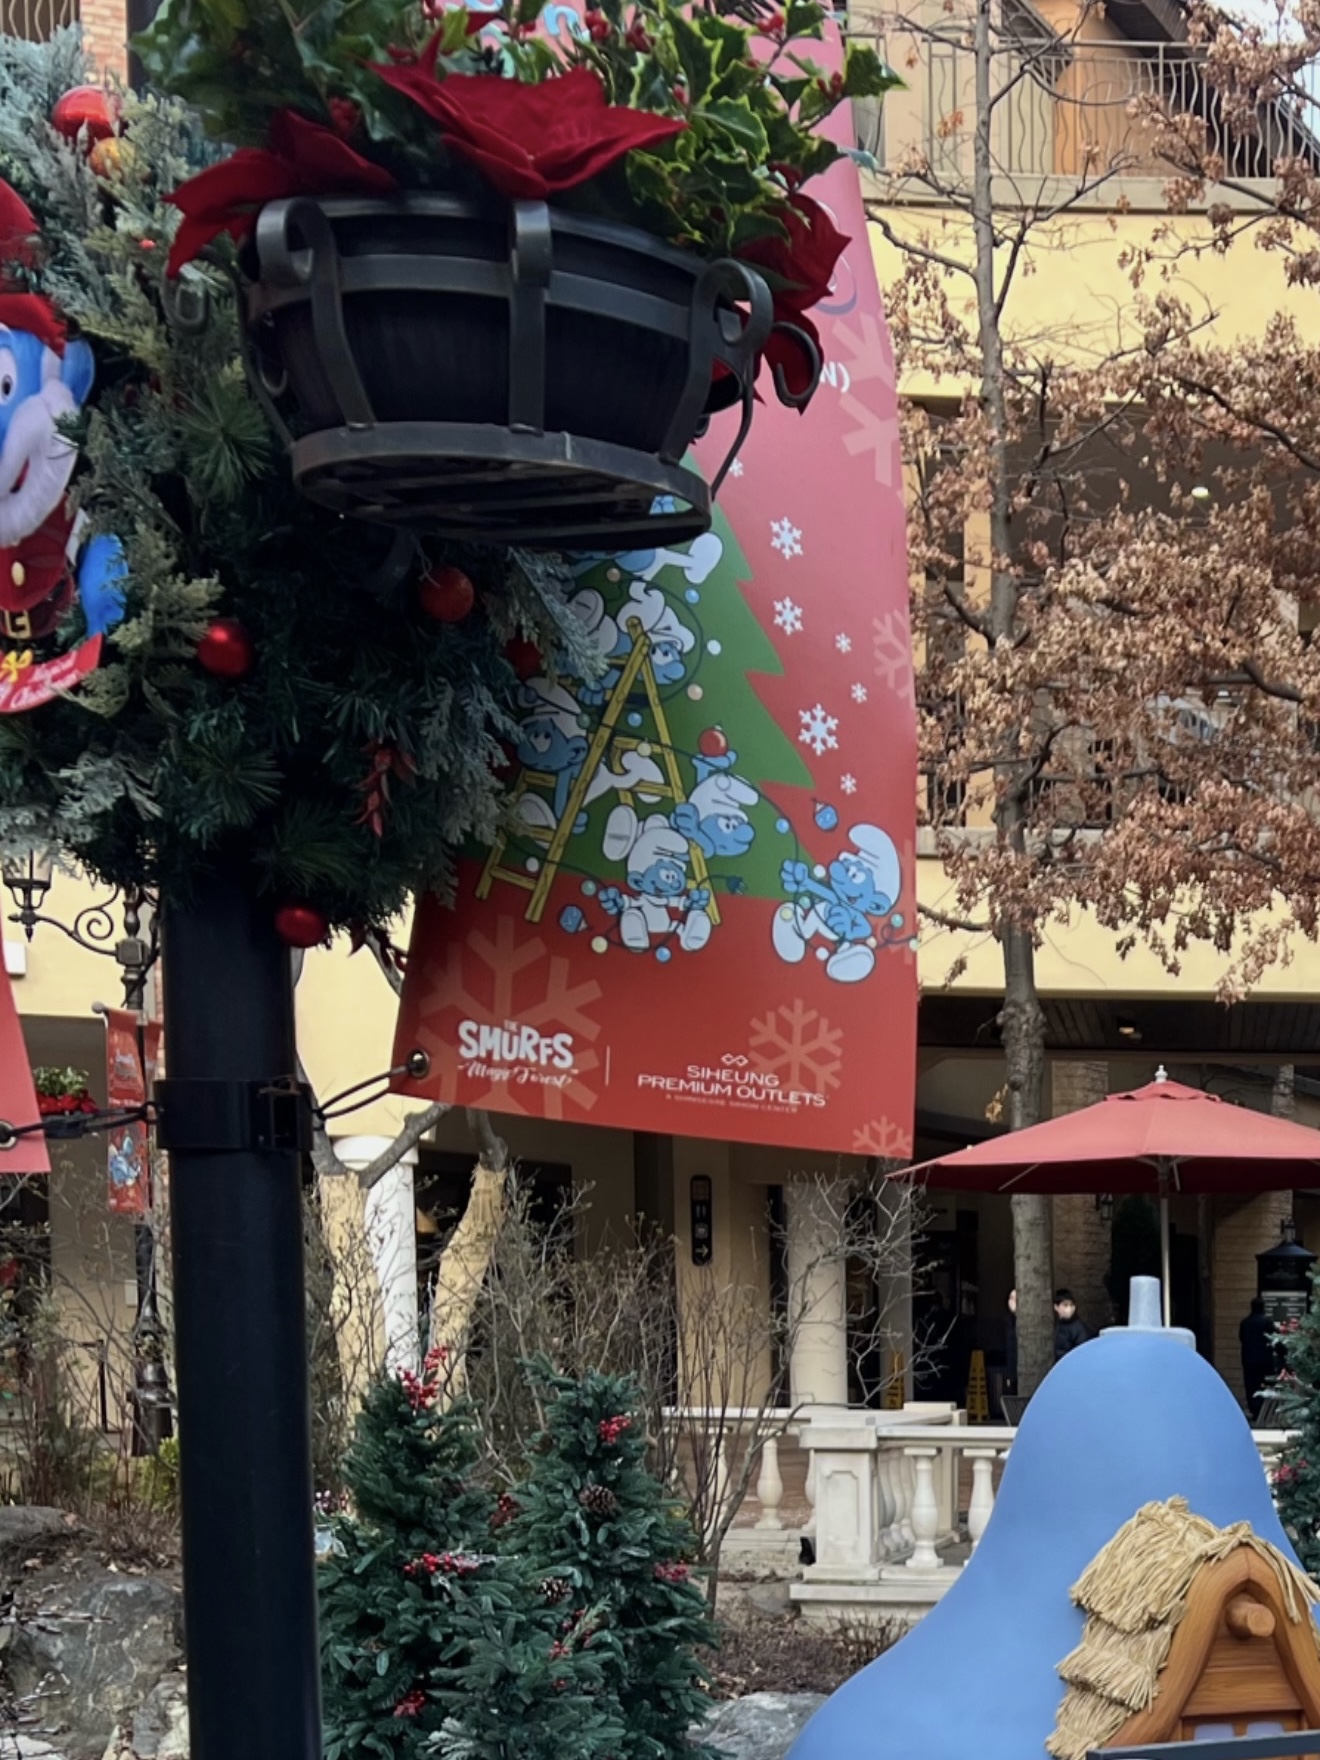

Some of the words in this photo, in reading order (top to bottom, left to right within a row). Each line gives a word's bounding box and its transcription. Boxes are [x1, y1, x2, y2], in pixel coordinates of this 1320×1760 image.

[458, 1020, 574, 1069] SMURFS
[638, 1074, 732, 1097] PREMIUM
[736, 1085, 827, 1107] OUTLETS
[687, 1065, 780, 1087] SIHEUNG
